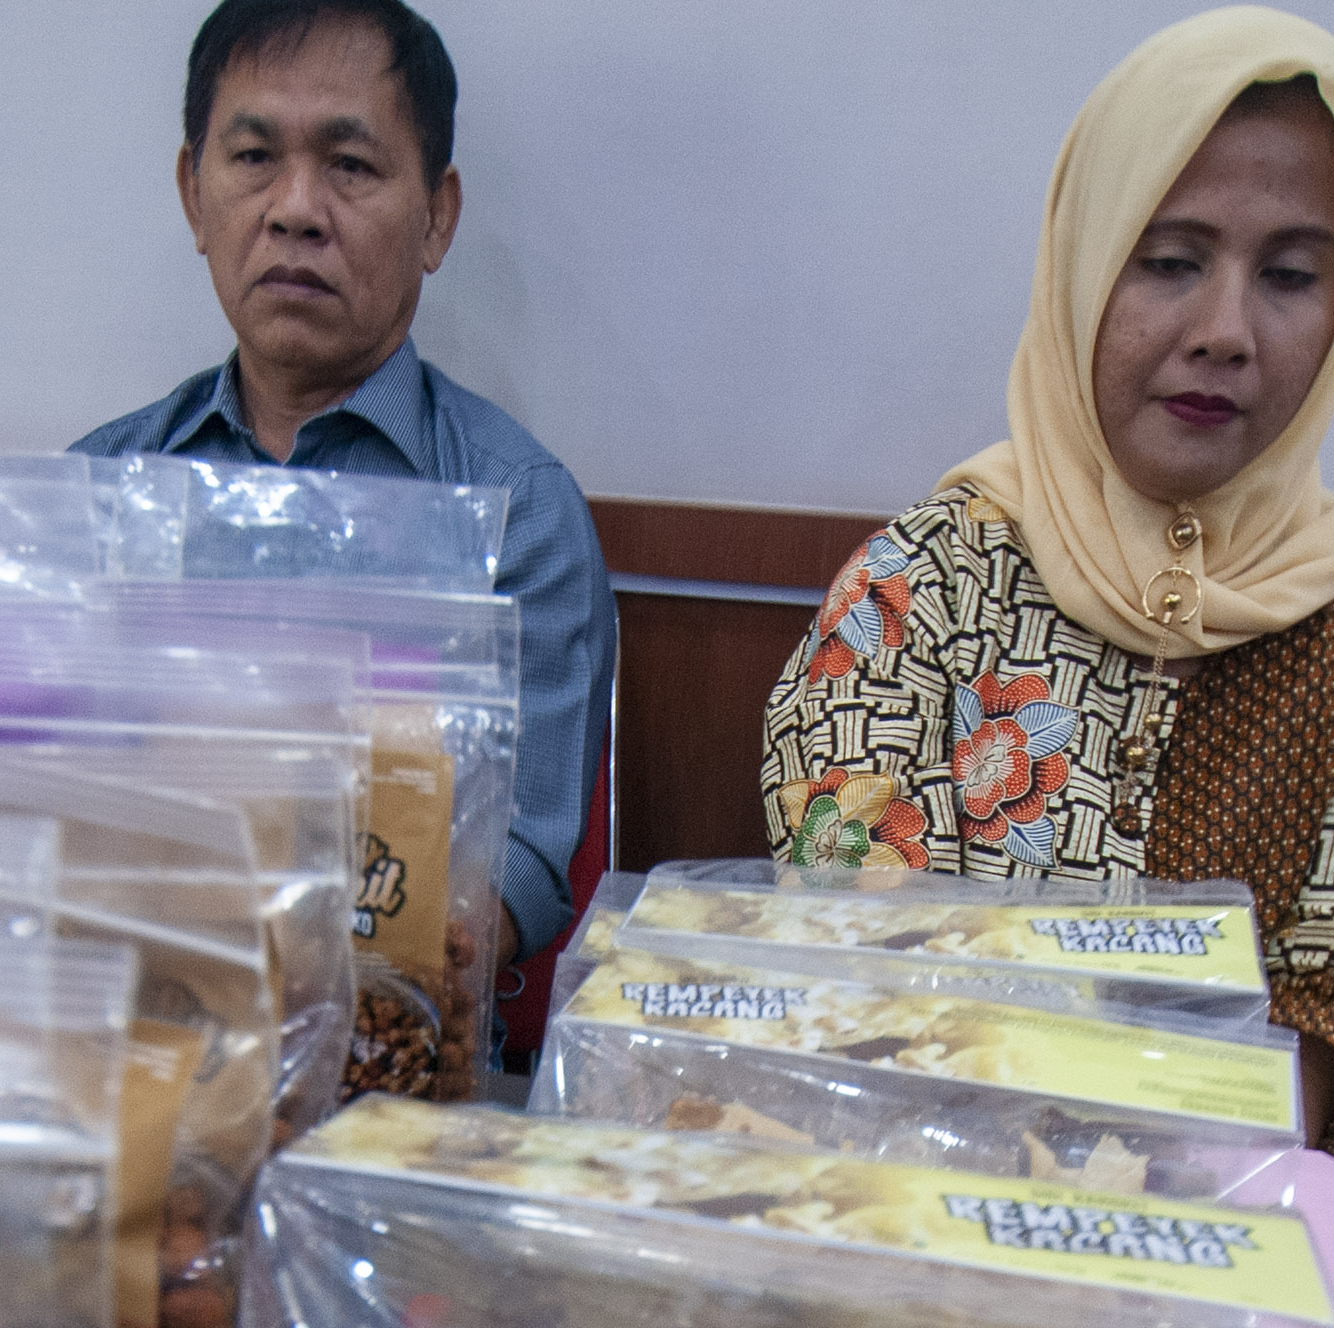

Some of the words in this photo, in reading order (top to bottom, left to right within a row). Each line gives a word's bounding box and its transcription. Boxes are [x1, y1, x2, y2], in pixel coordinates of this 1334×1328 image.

[1058, 932, 1208, 956] KACANG
[622, 982, 807, 1006] REMPEYEK
[643, 998, 786, 1020] KACANG
[941, 1193, 1263, 1252] REMPEYEK
[987, 1220, 1235, 1269] KACANG
